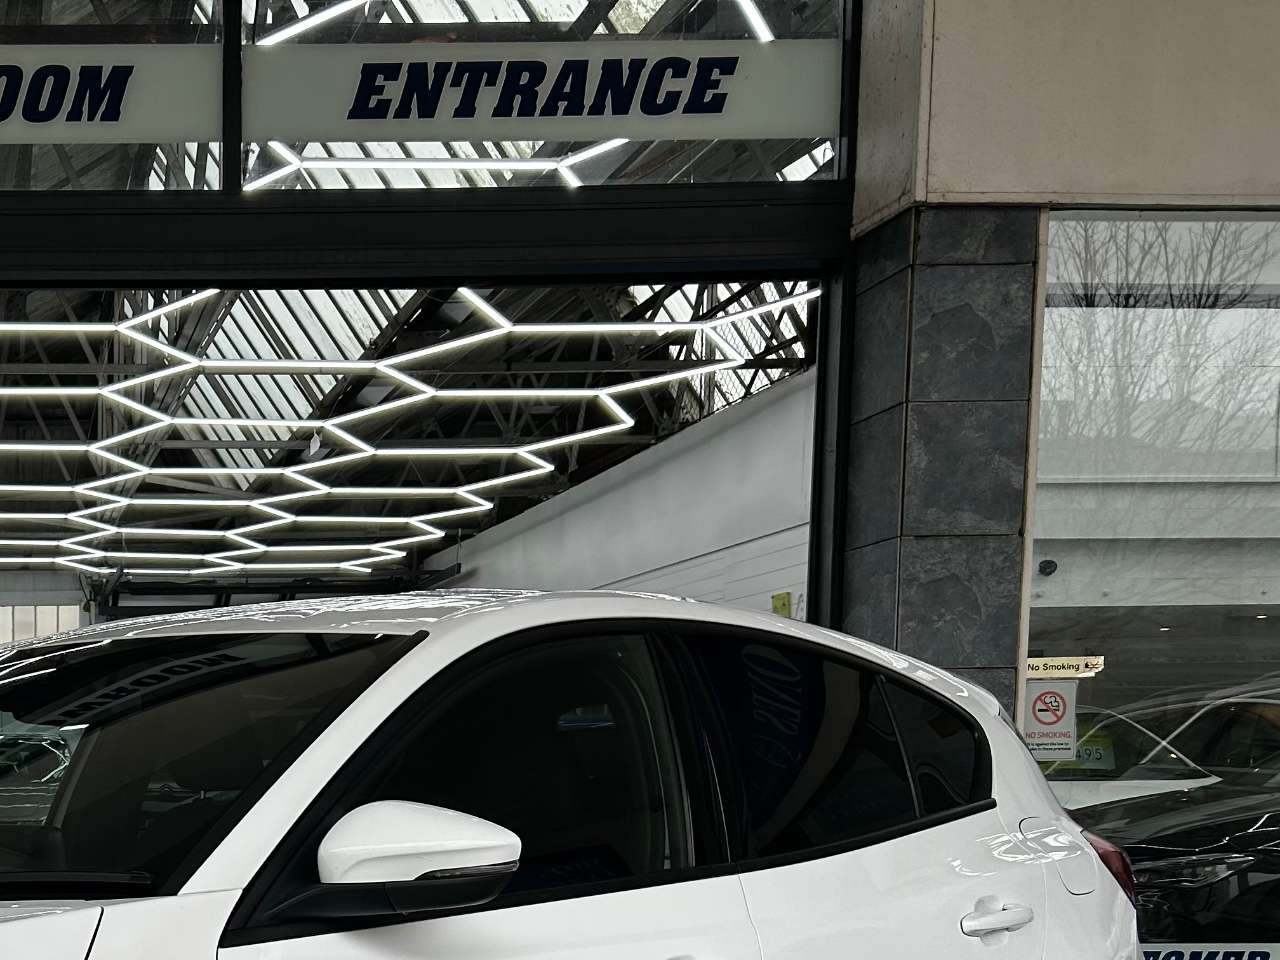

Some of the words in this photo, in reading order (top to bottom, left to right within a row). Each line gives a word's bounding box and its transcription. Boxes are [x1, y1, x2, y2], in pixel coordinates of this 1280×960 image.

[347, 56, 739, 120] ENTRANCE
[1042, 663, 1080, 671] Smoking
[1038, 731, 1071, 739] SMOKING
